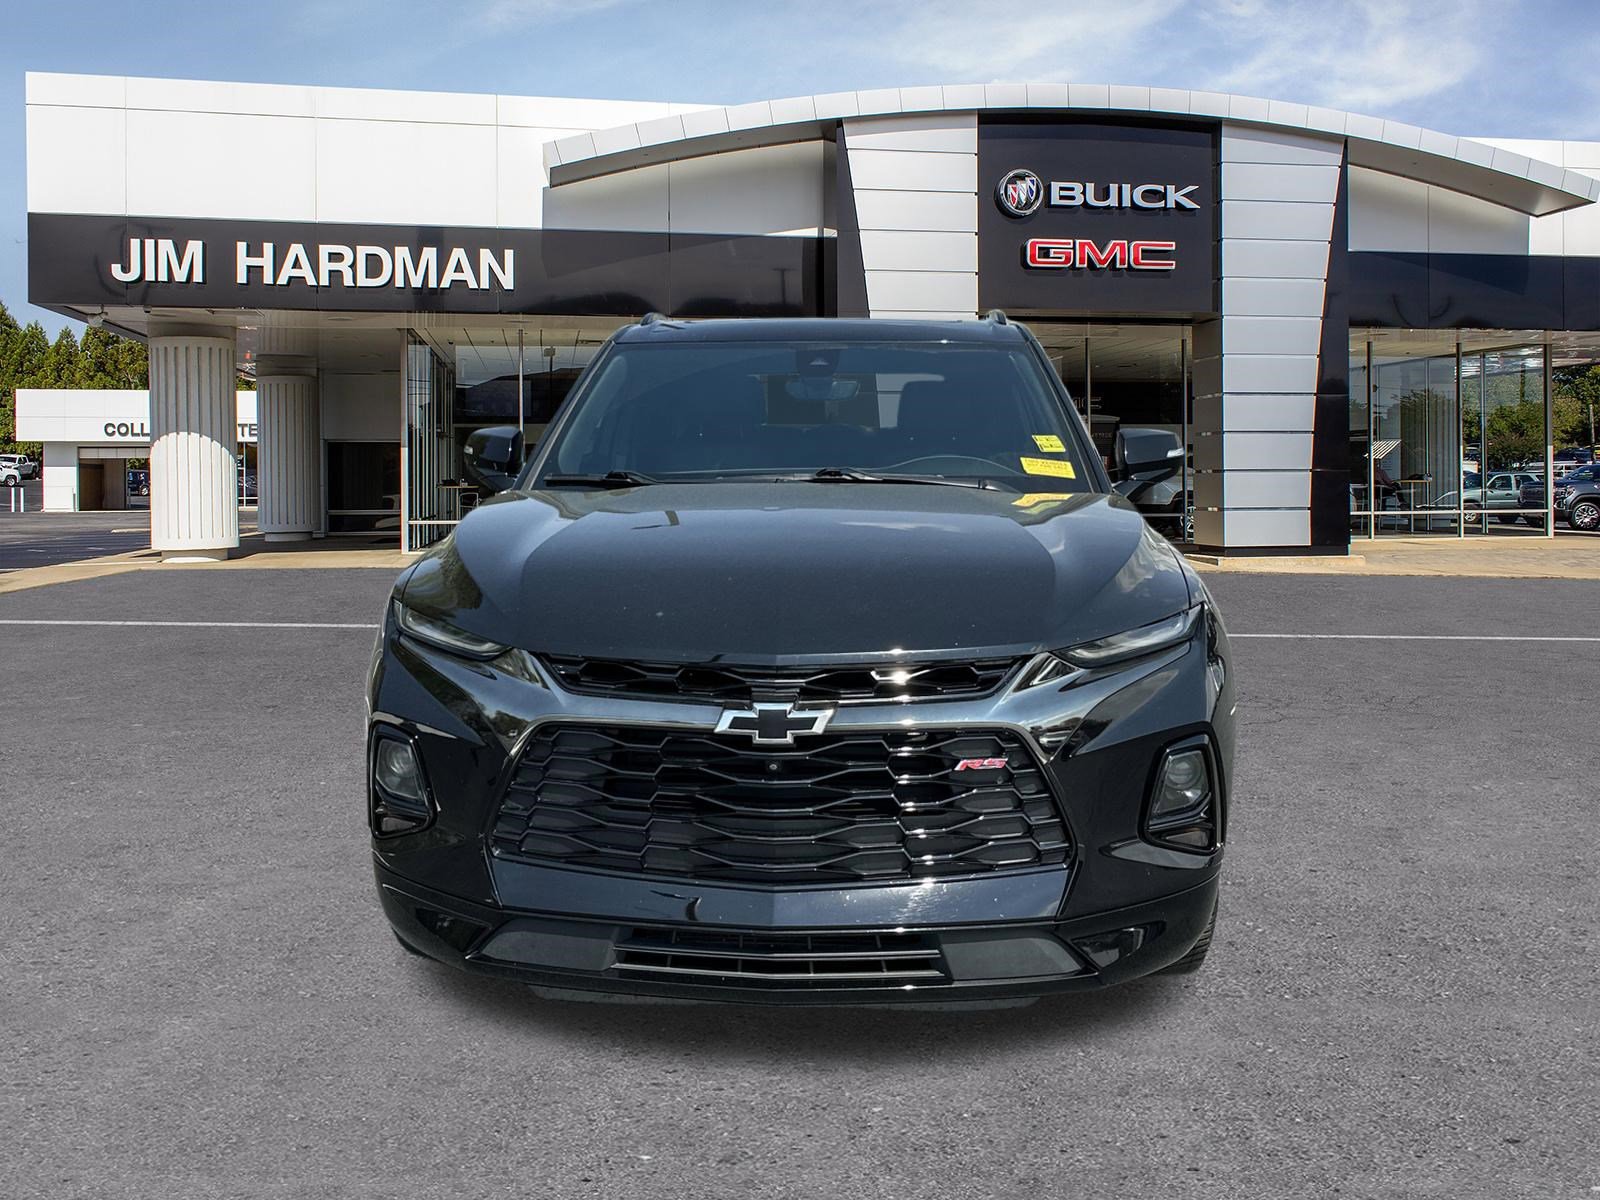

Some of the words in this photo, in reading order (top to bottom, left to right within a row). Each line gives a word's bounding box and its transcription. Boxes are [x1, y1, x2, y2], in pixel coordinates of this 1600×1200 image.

[1050, 181, 1201, 209] BUICK
[111, 238, 204, 283] JIM
[235, 240, 515, 291] HARDMAN
[1026, 238, 1176, 270] GMC
[954, 758, 1008, 771] RS
